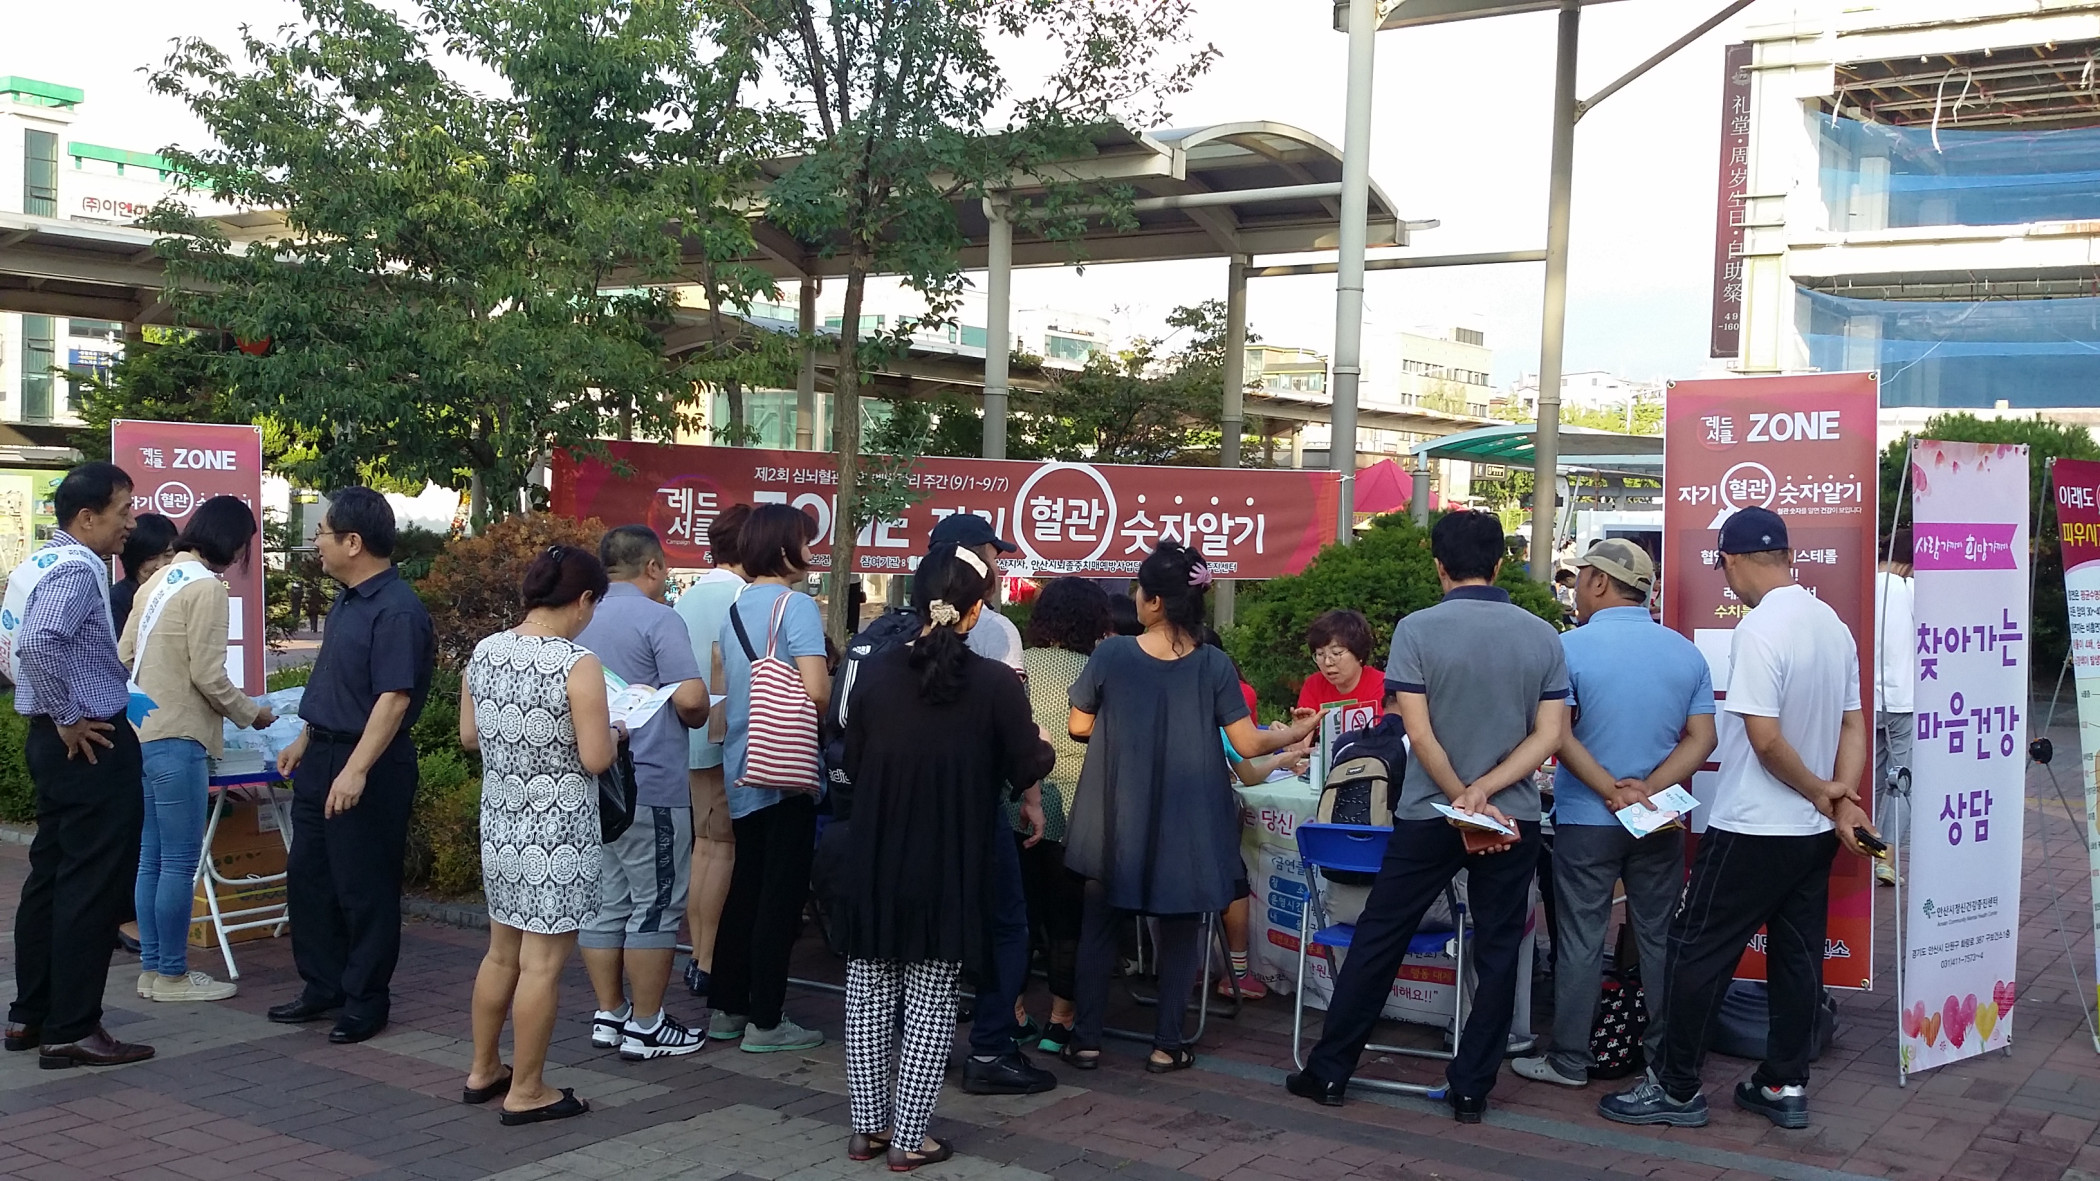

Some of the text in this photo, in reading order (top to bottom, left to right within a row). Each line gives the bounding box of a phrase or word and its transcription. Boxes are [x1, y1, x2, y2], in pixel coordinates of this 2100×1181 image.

[1701, 416, 1734, 431] 레드
[1747, 411, 1840, 442] ZONE
[1706, 430, 1737, 444] 서클
[140, 447, 163, 459] 레드
[173, 448, 236, 470] ZONE
[755, 467, 789, 483] 제2회
[923, 475, 948, 489] 주간
[950, 475, 1009, 492] (9/1~9/7)
[1678, 478, 1861, 505] 자기 혈관 숫자알기
[160, 493, 189, 508] 혈관
[657, 488, 720, 515] 레드
[2059, 486, 2095, 508] 이래도
[1030, 496, 1104, 542] 혈관
[1120, 512, 1265, 556] 숫자알기
[666, 538, 691, 546] Campaign
[1793, 549, 1838, 564] 스테롤
[1917, 608, 2023, 681] 찾아가는
[1918, 692, 2019, 760] 마음건강
[1262, 810, 1293, 836] 당신
[1940, 789, 1993, 846] 상담
